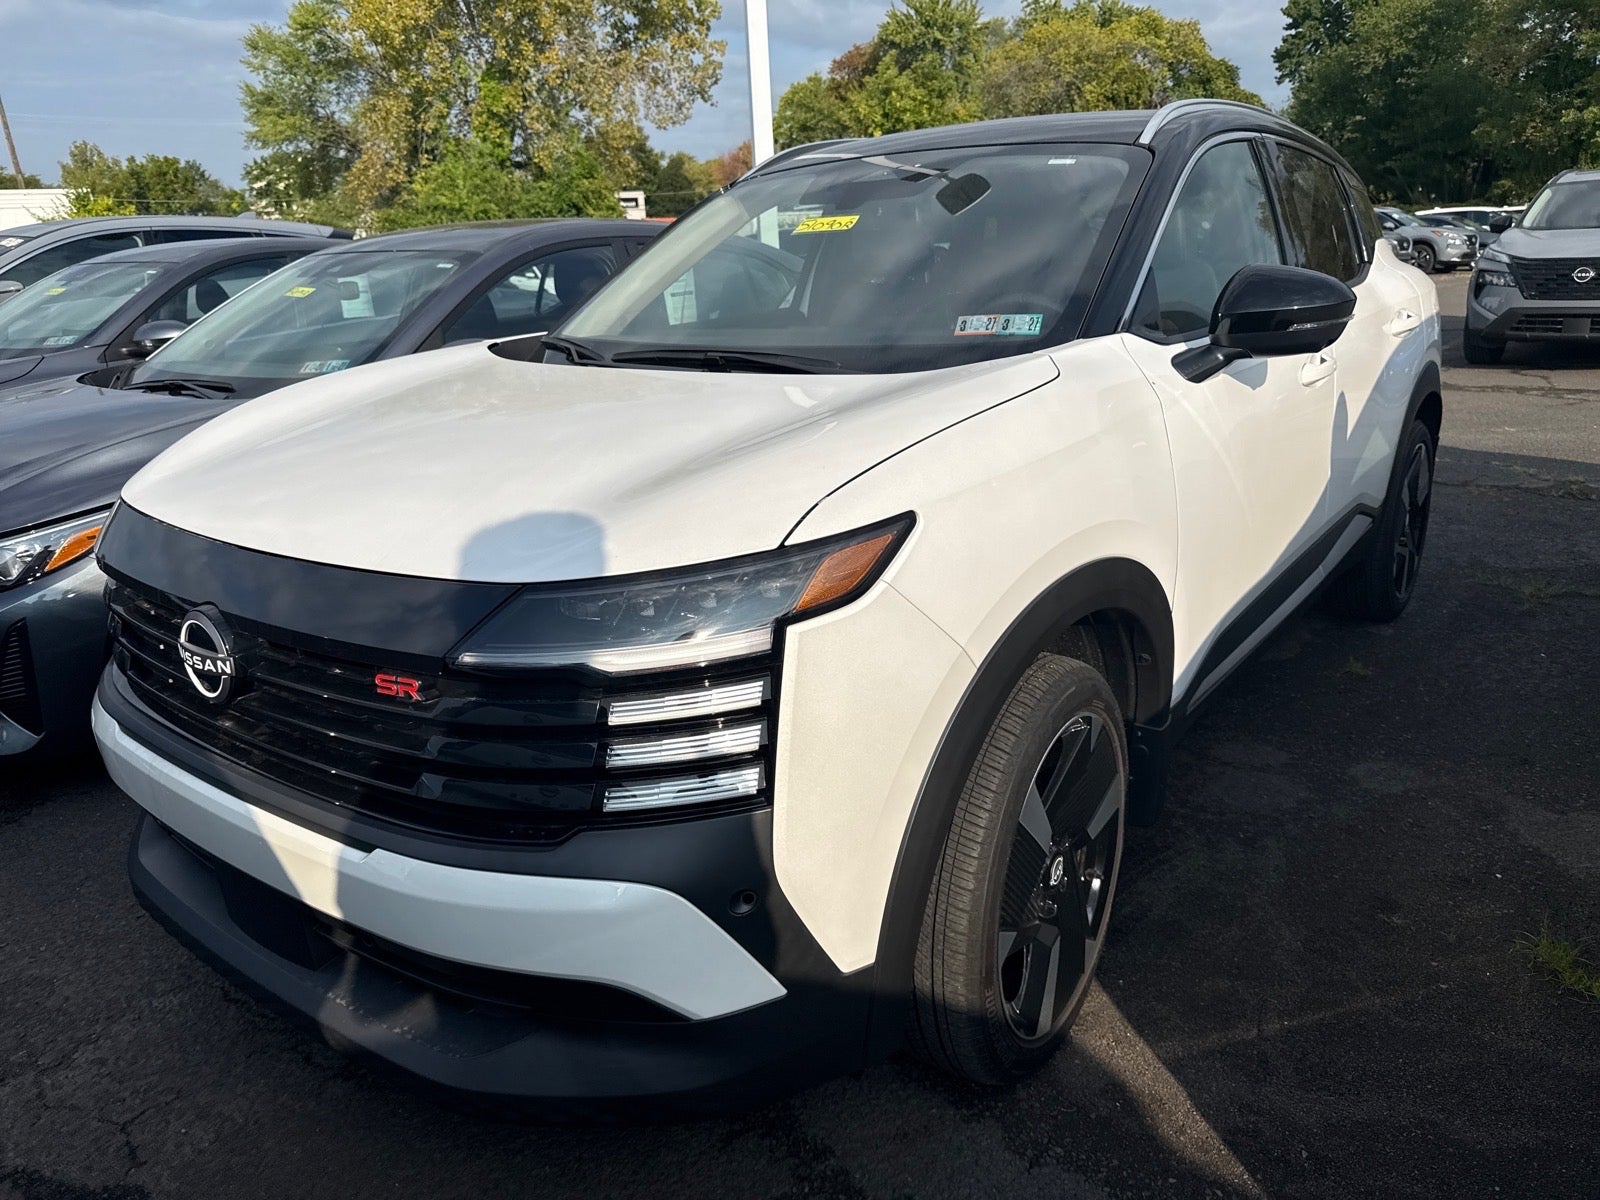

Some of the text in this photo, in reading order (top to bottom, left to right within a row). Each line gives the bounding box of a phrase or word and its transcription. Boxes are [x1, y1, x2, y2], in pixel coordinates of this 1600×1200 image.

[985, 316, 997, 331] 27
[1028, 316, 1040, 331] 27
[178, 643, 232, 674] NISSAN
[375, 673, 421, 700] SR
